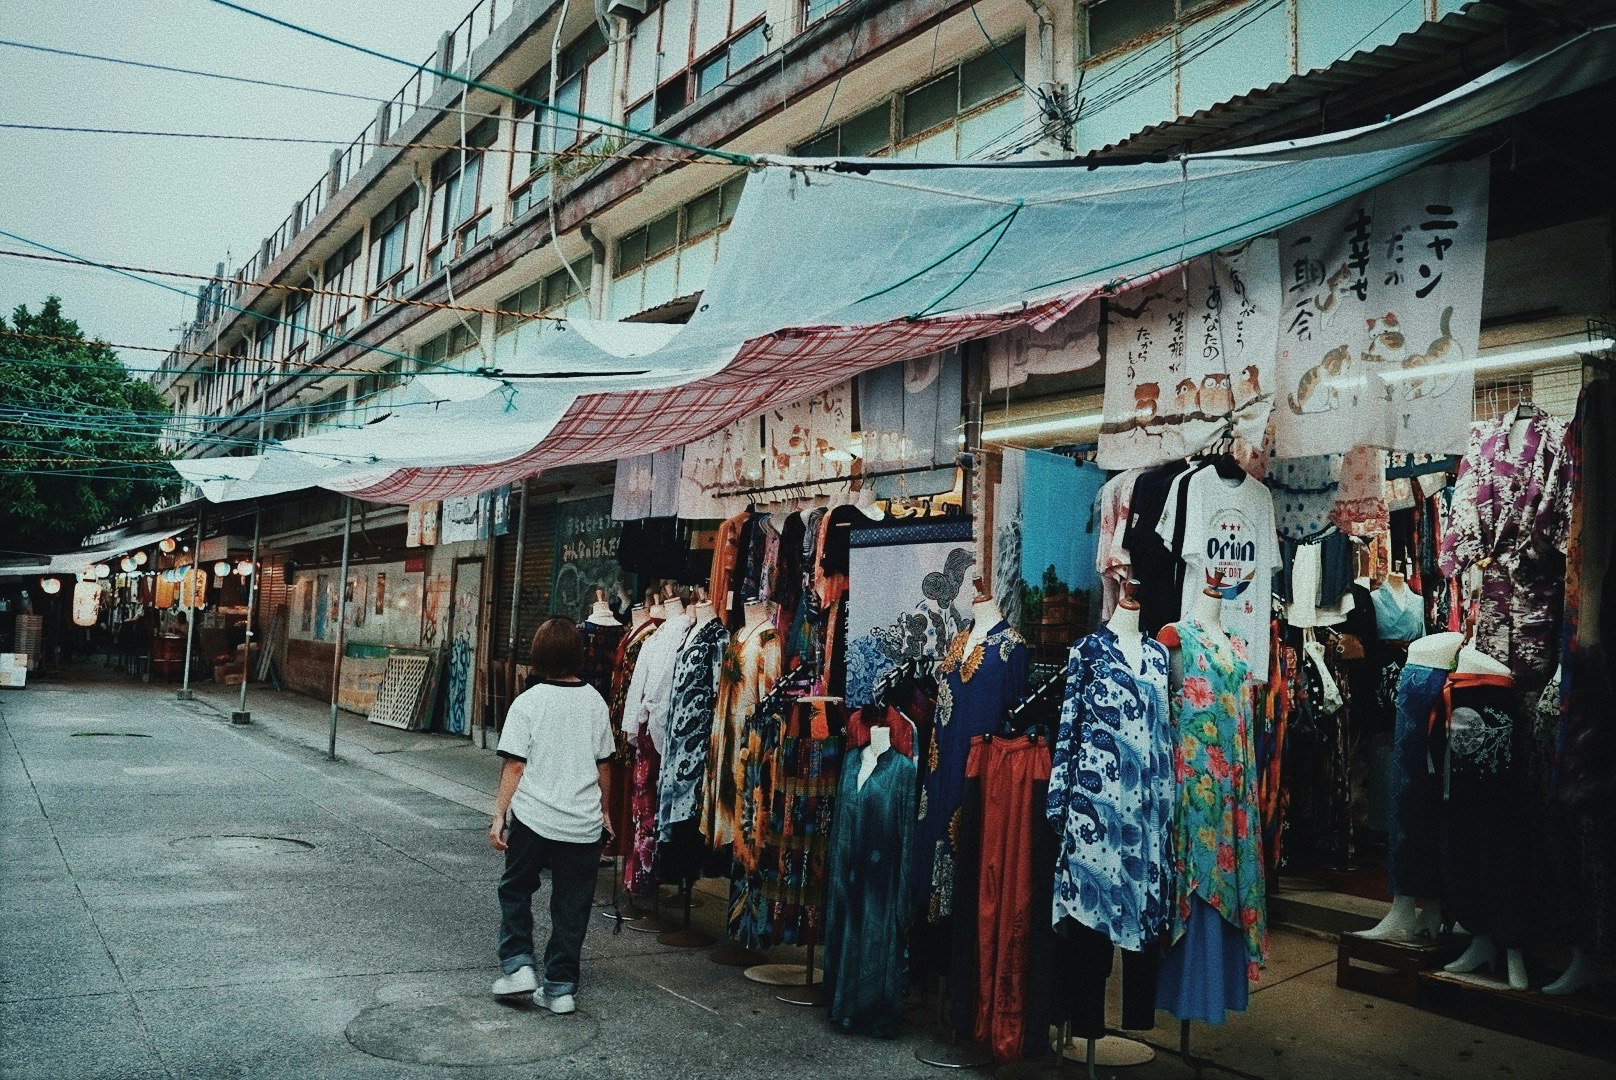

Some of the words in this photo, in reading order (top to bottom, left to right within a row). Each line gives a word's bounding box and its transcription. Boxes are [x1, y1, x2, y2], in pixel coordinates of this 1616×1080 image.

[1344, 207, 1372, 301] 幸せ
[1416, 204, 1458, 299] ニャン
